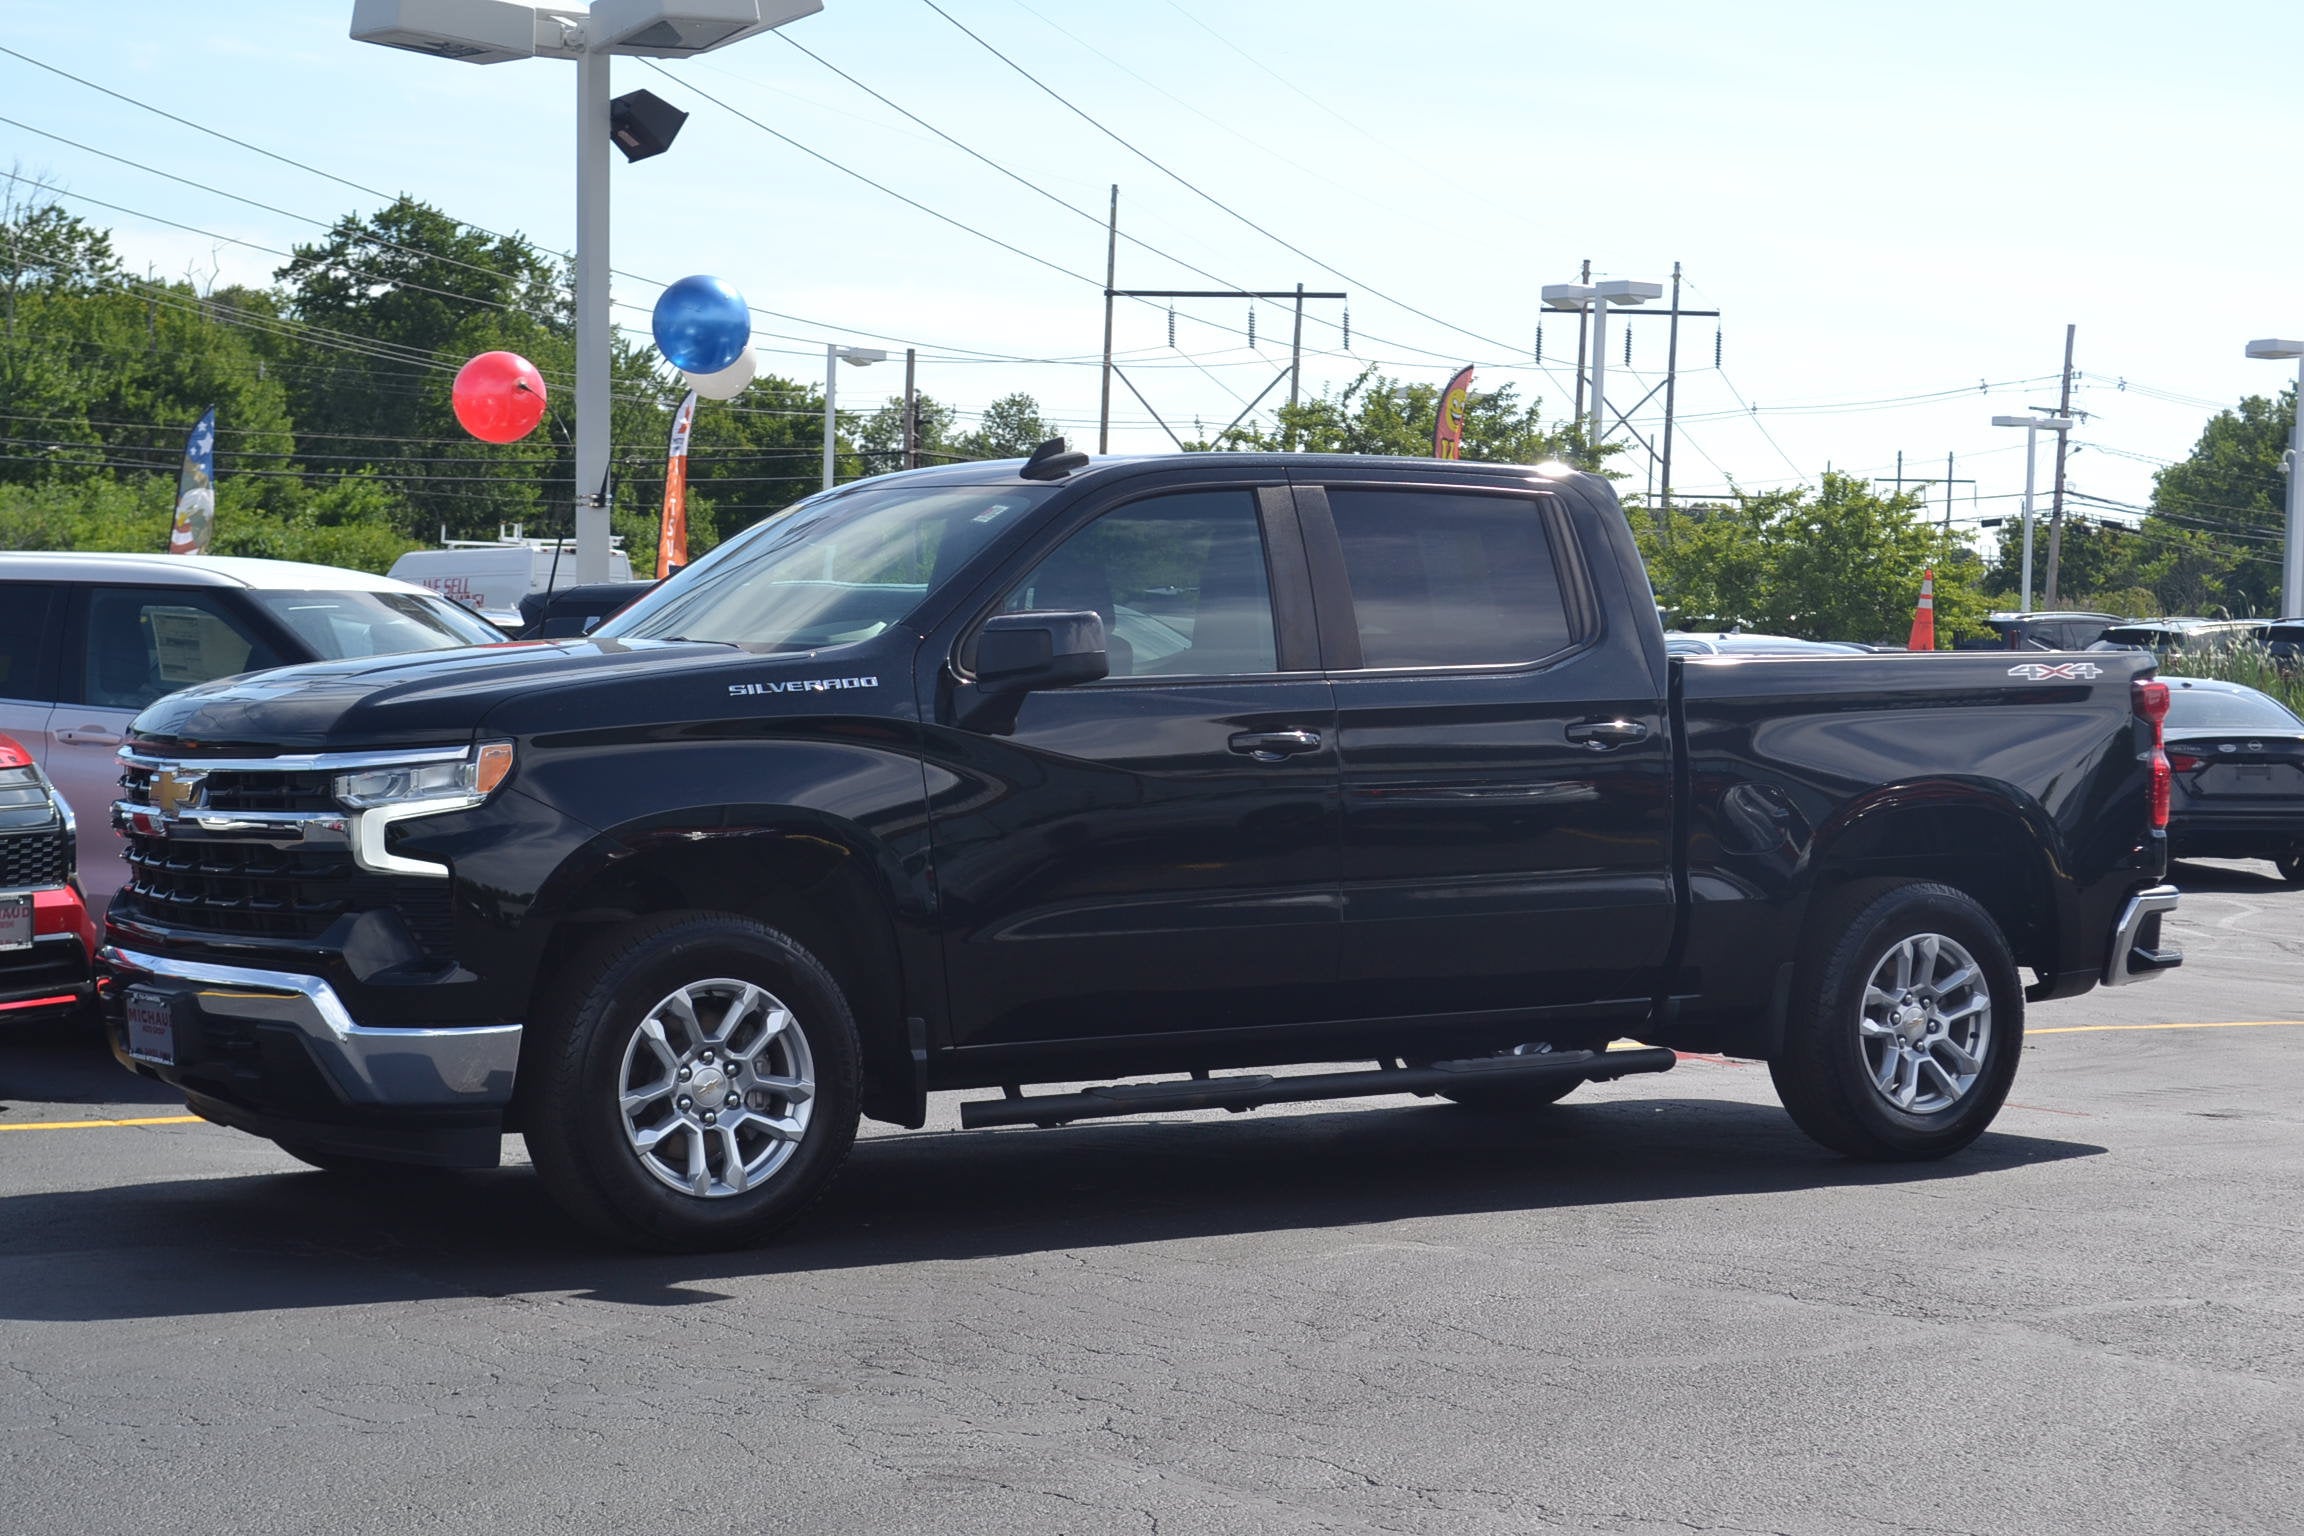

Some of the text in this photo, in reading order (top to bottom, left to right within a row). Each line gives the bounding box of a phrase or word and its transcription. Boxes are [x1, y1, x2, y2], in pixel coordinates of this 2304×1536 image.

[444, 577, 470, 594] SELL
[728, 676, 879, 696] SILVERADO
[0, 907, 30, 919] AUD
